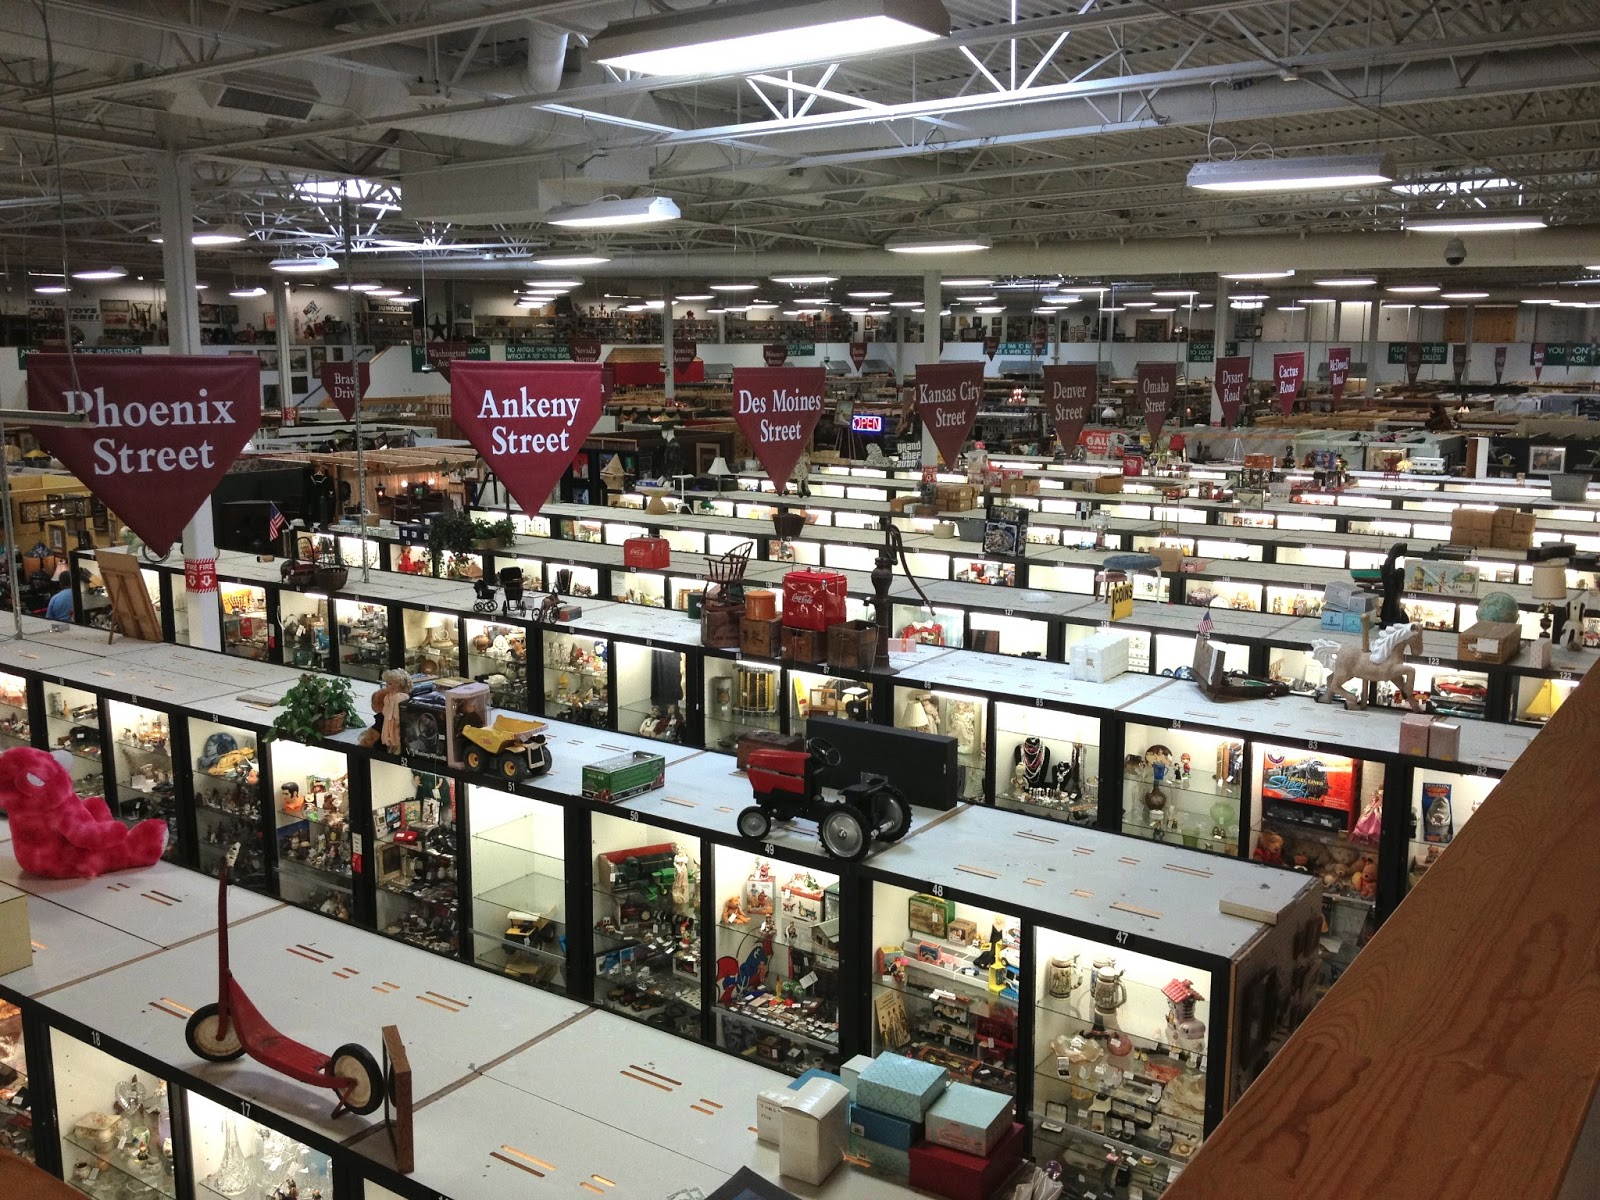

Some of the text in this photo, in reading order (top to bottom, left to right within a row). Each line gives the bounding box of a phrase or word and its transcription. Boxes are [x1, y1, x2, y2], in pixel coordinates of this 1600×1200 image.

[429, 348, 466, 359] Washington
[574, 346, 597, 354] Nevada
[1547, 346, 1564, 354] YOU
[334, 372, 355, 384] Bras
[1279, 365, 1298, 378] Cactus
[1142, 376, 1169, 394] Omaha
[1222, 370, 1243, 388] Dysart
[334, 387, 355, 399] Driv
[919, 381, 981, 406] Kansas City
[1052, 381, 1087, 399] Denver
[1279, 380, 1295, 394] Road
[1223, 386, 1240, 402] Road
[62, 386, 236, 428] Phoenix
[477, 386, 581, 426] Ankeny
[738, 388, 821, 414] Des Moines
[1144, 398, 1166, 413] Street
[935, 408, 966, 428] Street
[1055, 404, 1083, 421] Street
[853, 416, 879, 430] OPEN
[760, 419, 802, 443] Street
[491, 426, 570, 455] Street
[897, 440, 921, 453] grand
[93, 438, 215, 476] Street
[896, 460, 916, 468] auto
[186, 563, 197, 571] FIRE
[1428, 657, 1439, 665] 123
[1559, 672, 1571, 680] 122
[1035, 698, 1043, 707] 85
[212, 714, 219, 723] 54
[1172, 720, 1181, 728] 84
[1308, 741, 1318, 749] 83
[401, 757, 408, 767] 52
[1476, 766, 1487, 776] 82
[508, 782, 515, 792] 51
[1265, 775, 1307, 789] Super
[630, 811, 639, 821] 50
[764, 843, 775, 855] 49
[932, 884, 944, 897] 48
[1116, 931, 1128, 944] 47
[91, 1031, 101, 1047] 18
[240, 1101, 251, 1117] 17
